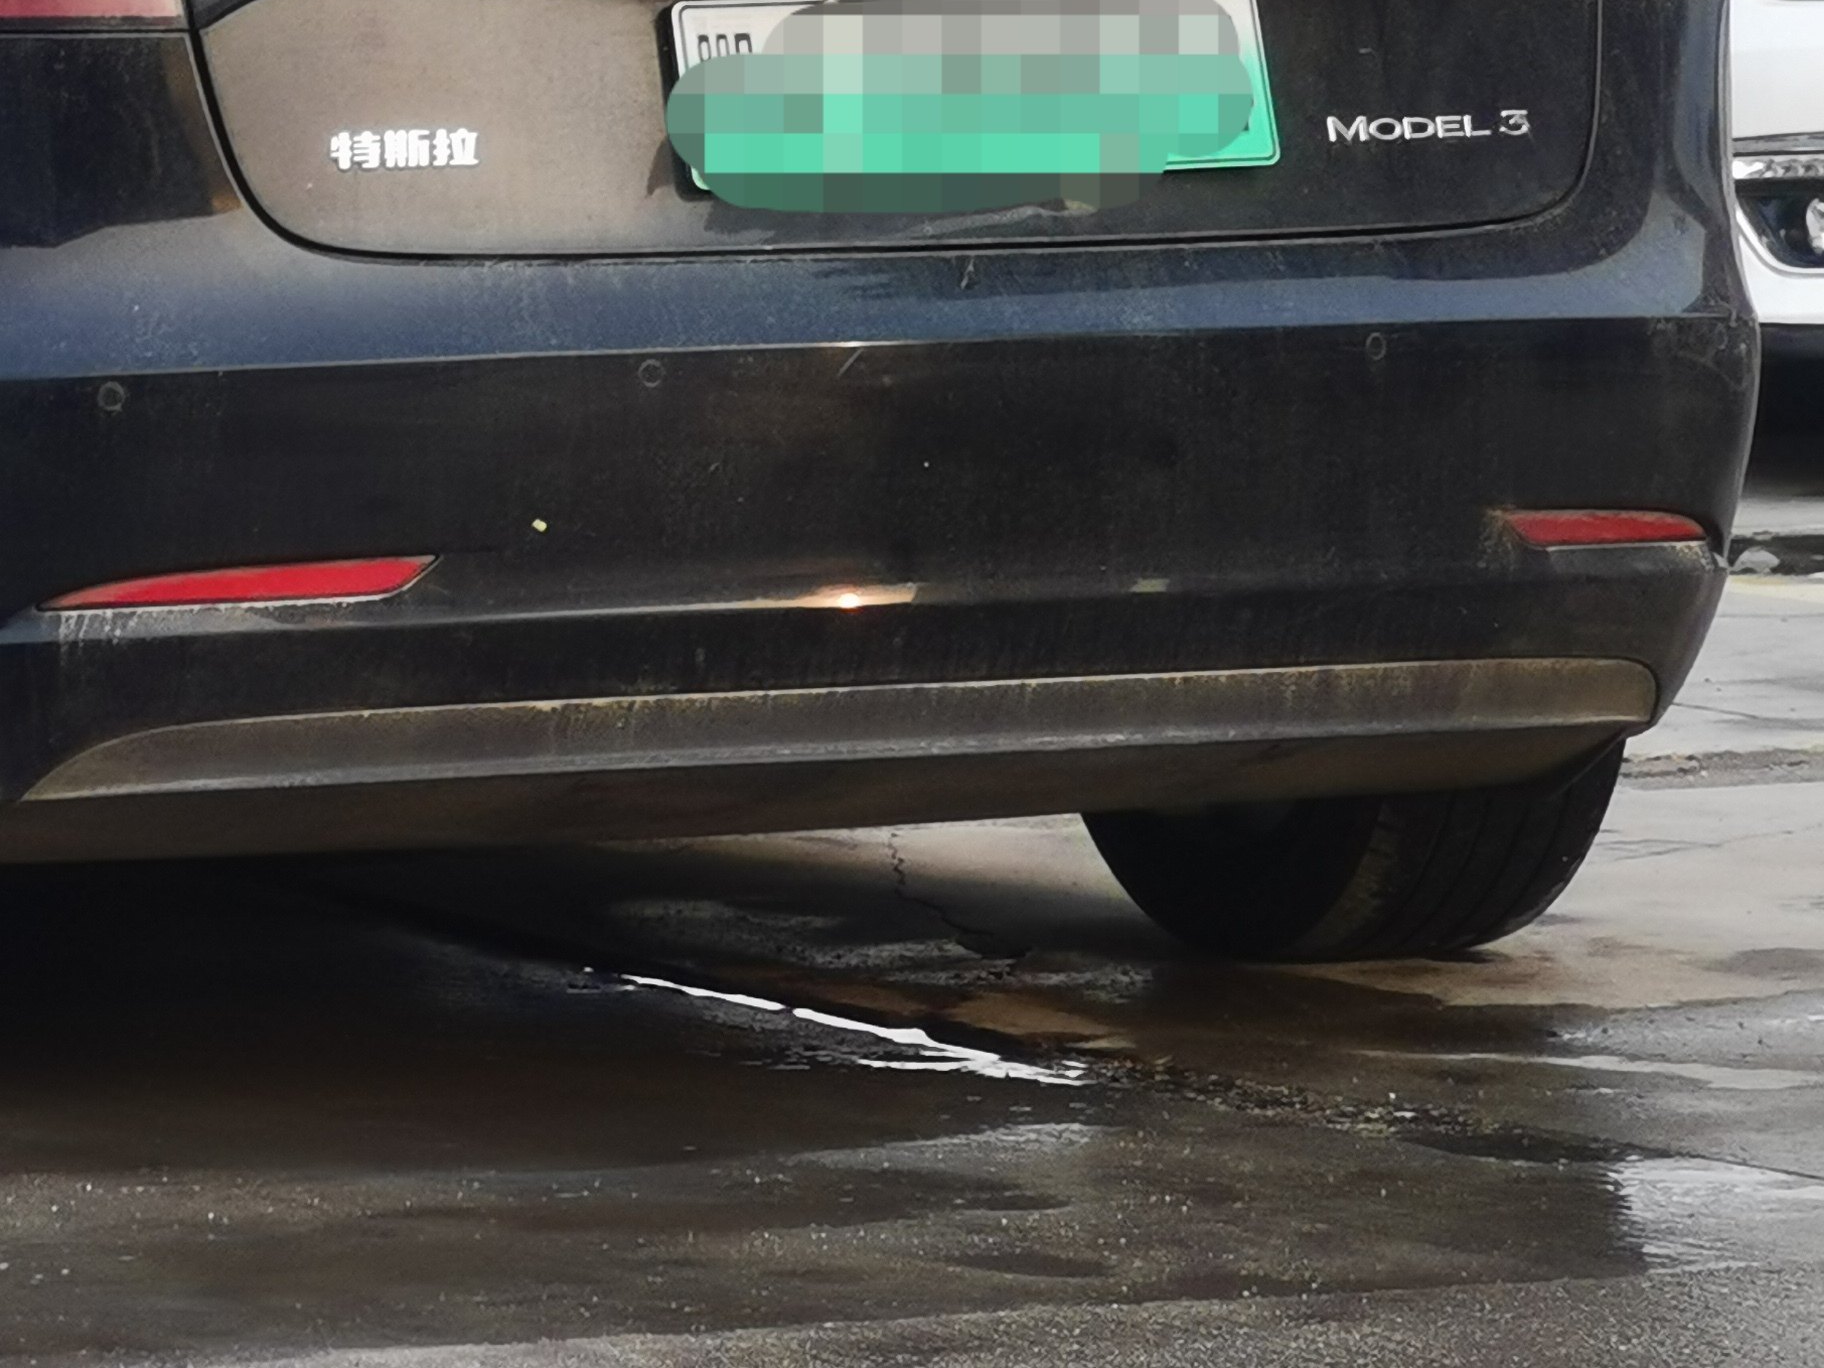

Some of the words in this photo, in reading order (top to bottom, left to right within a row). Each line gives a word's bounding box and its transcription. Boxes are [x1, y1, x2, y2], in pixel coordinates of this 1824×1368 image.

[1327, 114, 1492, 143] MODEL
[1499, 109, 1532, 137] 3
[330, 128, 479, 170] 特斯拉
